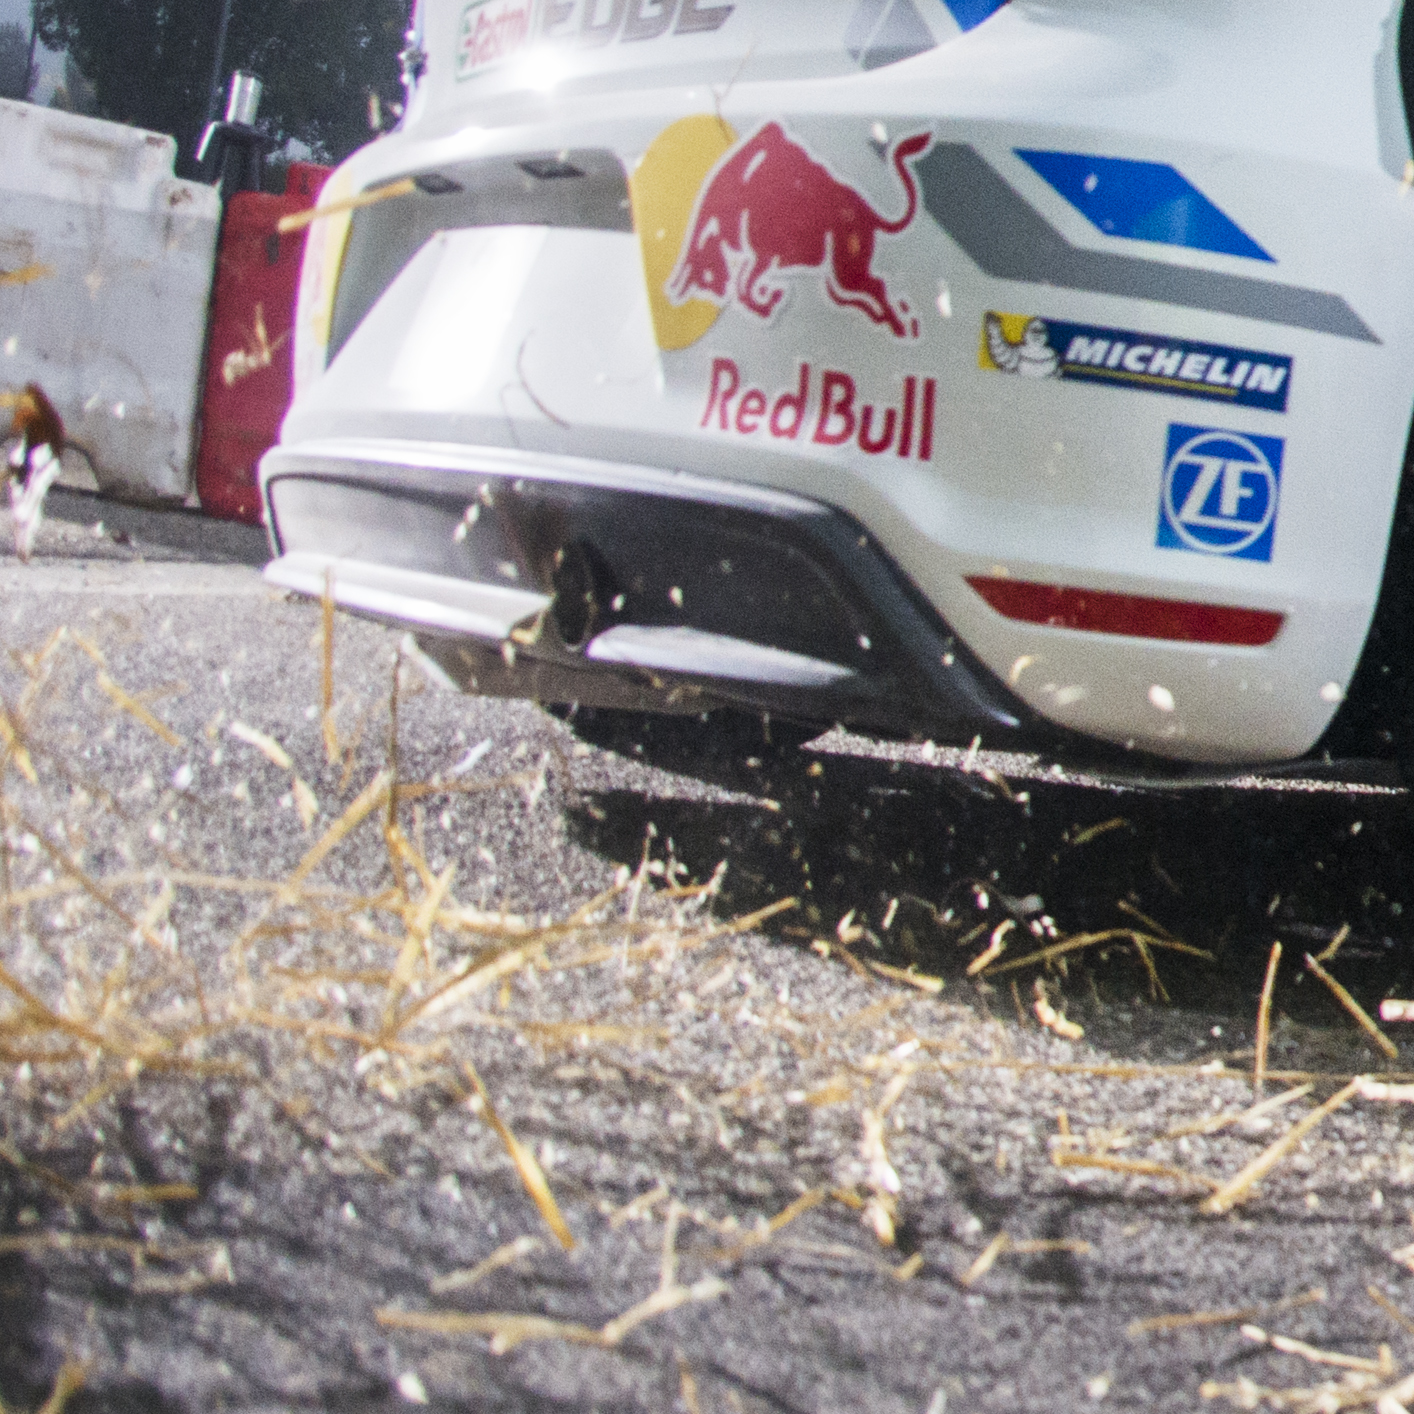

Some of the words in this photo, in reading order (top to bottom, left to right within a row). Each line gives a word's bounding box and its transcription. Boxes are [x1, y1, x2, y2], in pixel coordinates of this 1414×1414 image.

[1066, 334, 1289, 394] MICHELIN
[700, 357, 809, 441] Red
[810, 371, 937, 461] Bull
[1178, 452, 1265, 531] ZF
